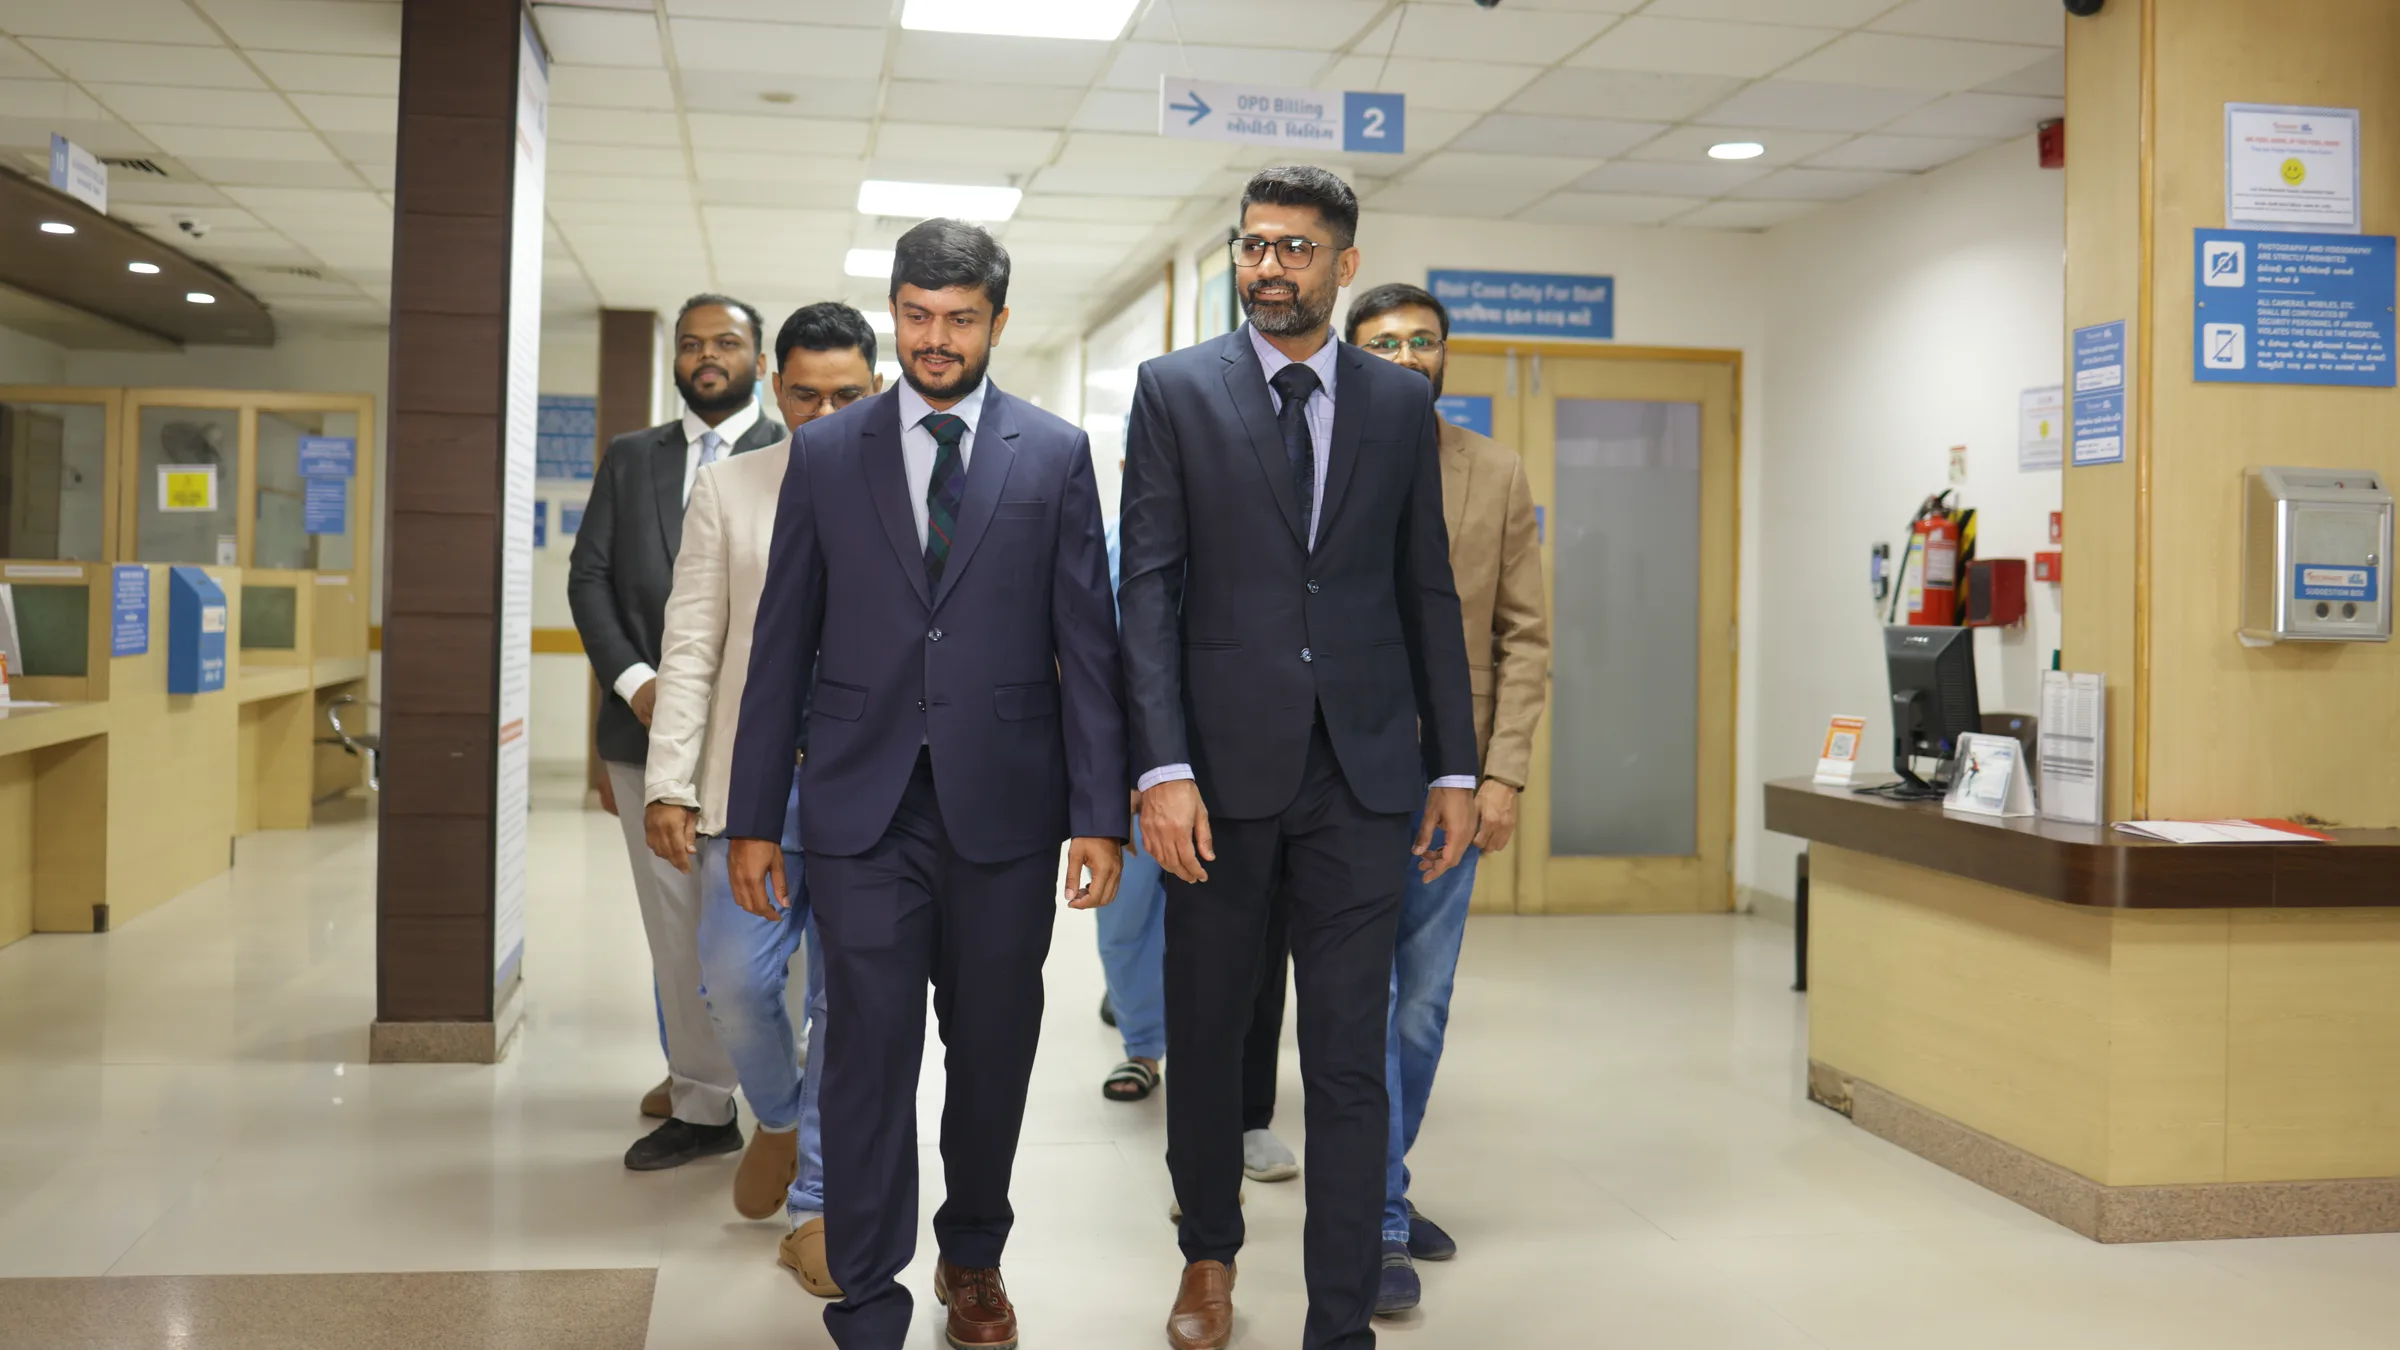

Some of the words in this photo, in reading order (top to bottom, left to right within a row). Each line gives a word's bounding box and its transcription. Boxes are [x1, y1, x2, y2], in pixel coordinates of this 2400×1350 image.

[1237, 94, 1269, 111] OPD
[1274, 97, 1323, 119] Billing
[1362, 107, 1386, 138] 2
[1435, 280, 1470, 298] Stair
[1470, 280, 1507, 299] Case
[1509, 282, 1542, 304] Only
[1545, 283, 1570, 302] For
[1573, 285, 1606, 303] Staff
